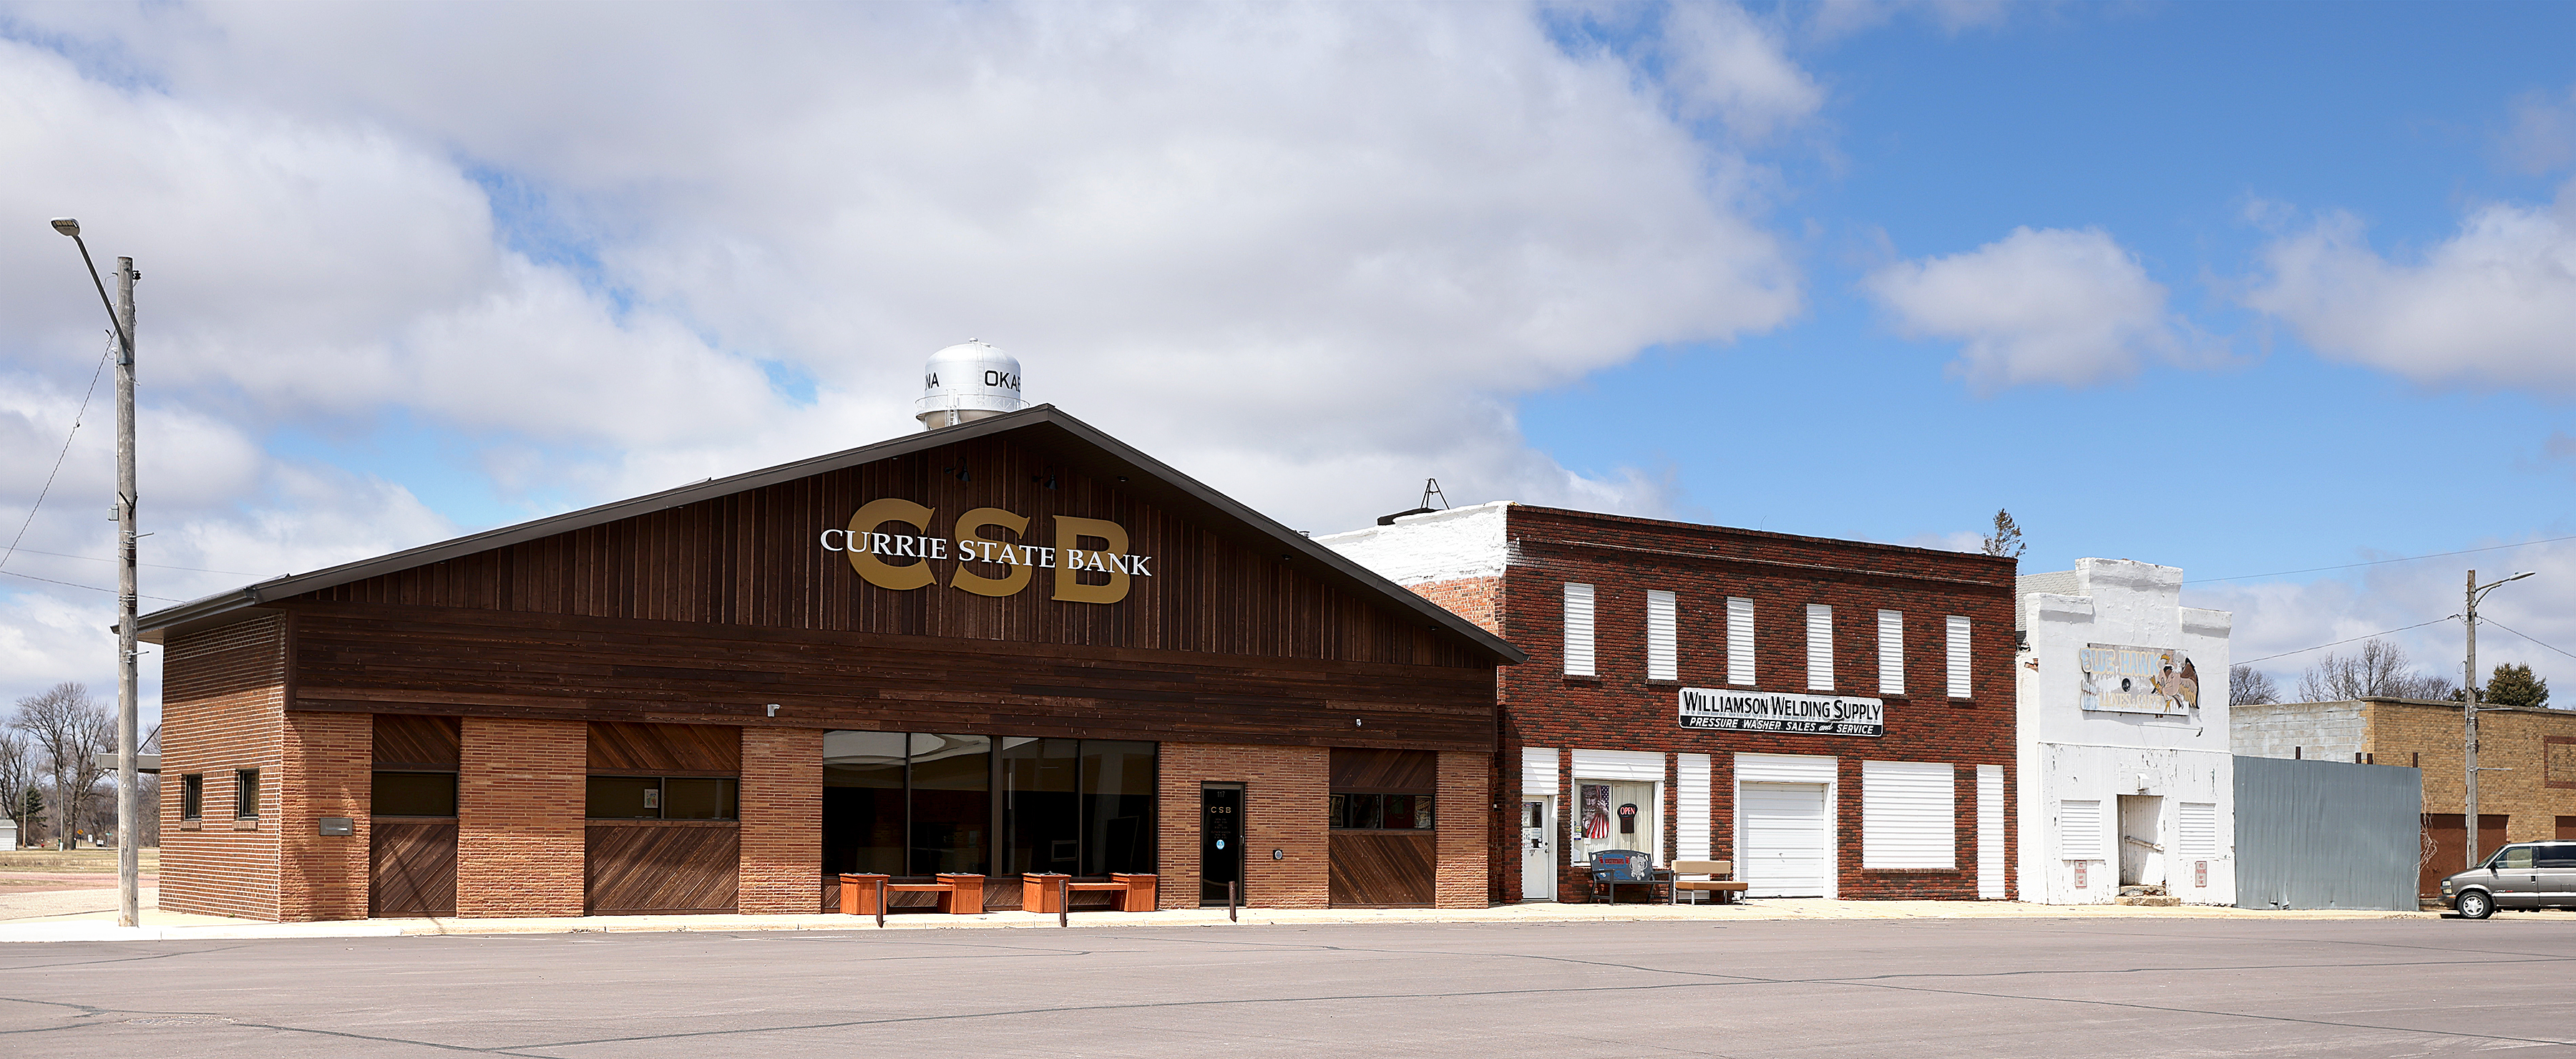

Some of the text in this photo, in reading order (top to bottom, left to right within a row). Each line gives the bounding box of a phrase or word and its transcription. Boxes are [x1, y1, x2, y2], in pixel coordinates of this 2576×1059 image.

[820, 529, 1152, 577] CURRIE STATE BANK
[847, 498, 1131, 604] CSB
[2079, 647, 2161, 677] BLUE HAWK
[1683, 690, 1881, 721] WILLIAMSON WELDING SUPPLY
[2098, 692, 2132, 708] LANES
[2137, 694, 2162, 709] CAFE
[1689, 717, 1874, 734] PRESSURE WASHER SALES and SERVICE
[1620, 806, 1636, 815] OPEN
